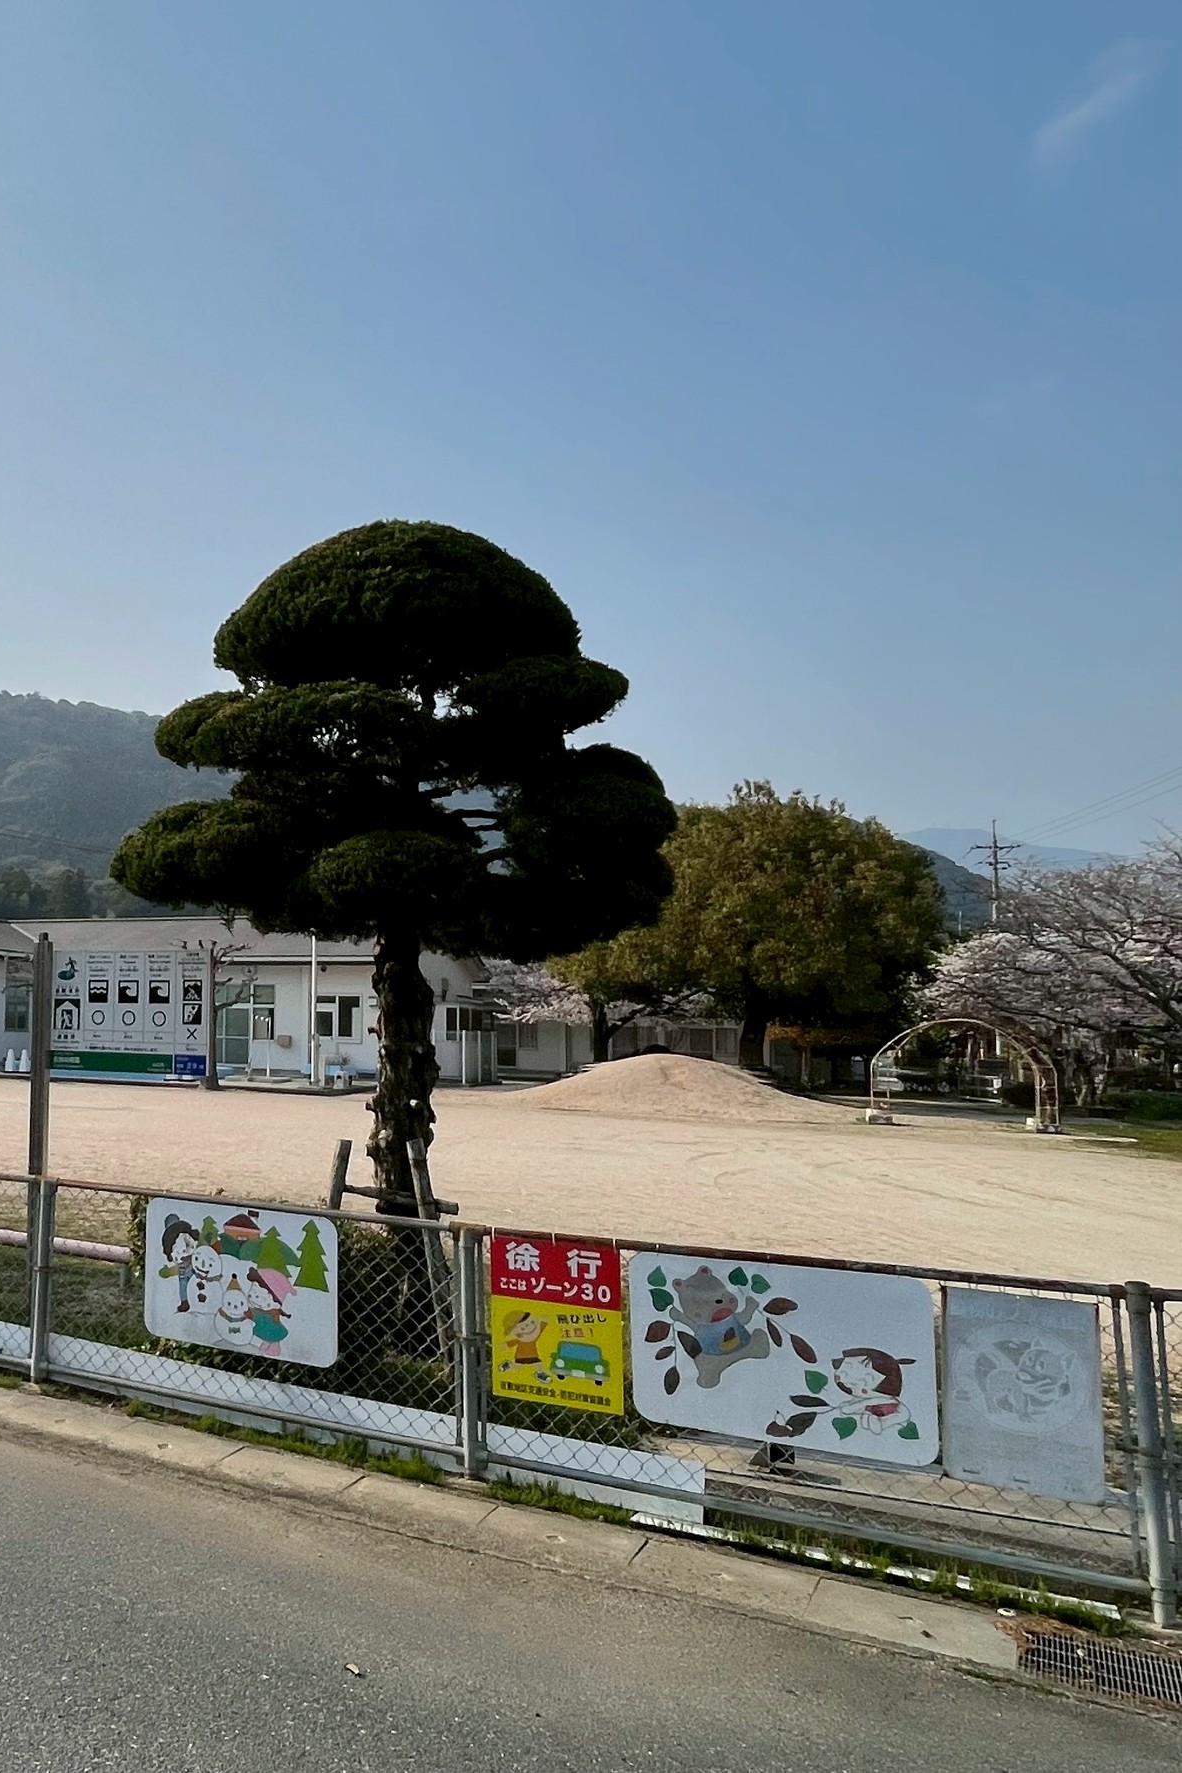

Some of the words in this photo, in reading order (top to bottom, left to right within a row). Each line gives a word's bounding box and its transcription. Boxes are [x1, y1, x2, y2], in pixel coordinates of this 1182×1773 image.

[505, 1241, 603, 1280] 徐行
[556, 1313, 607, 1325] 飛び出し
